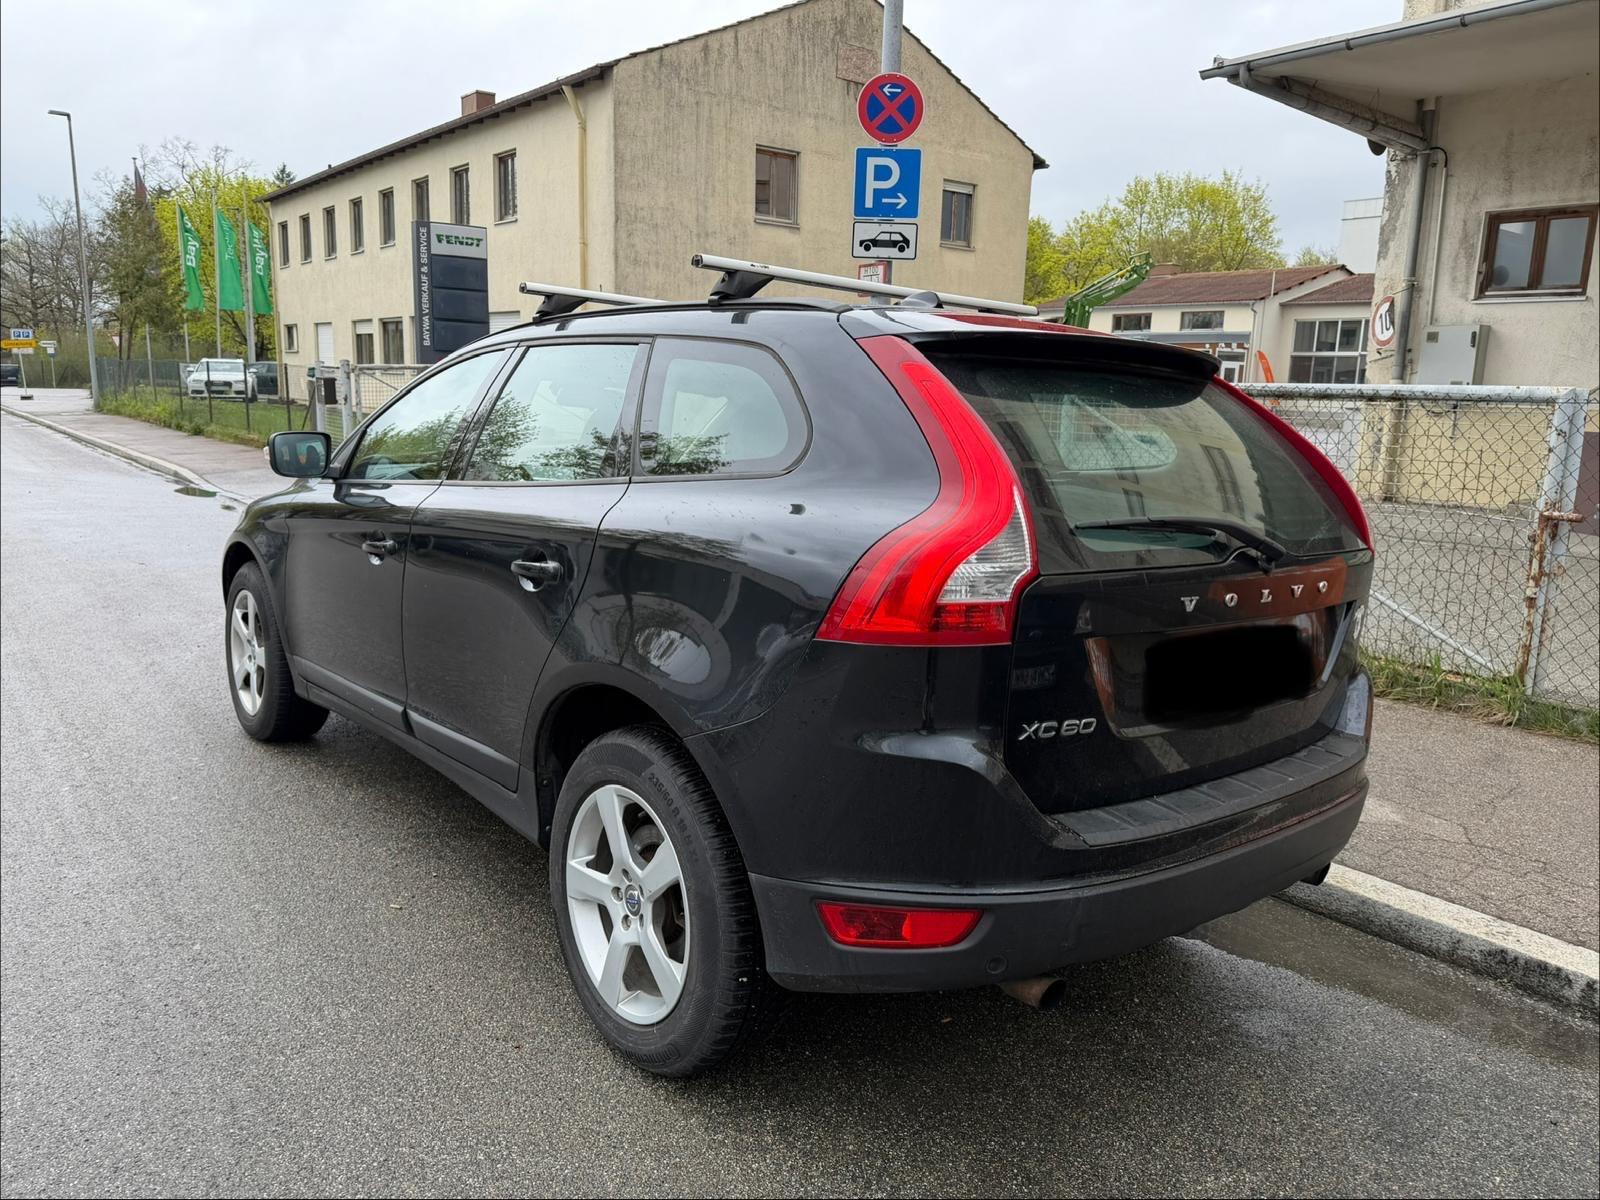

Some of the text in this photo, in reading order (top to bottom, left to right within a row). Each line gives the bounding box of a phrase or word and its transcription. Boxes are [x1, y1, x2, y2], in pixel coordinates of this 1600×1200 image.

[864, 156, 901, 209] P
[435, 233, 484, 248] FENDT
[420, 226, 431, 346] BAYWA VERKAUF & SERVICE
[1180, 580, 1329, 613] VOLVO
